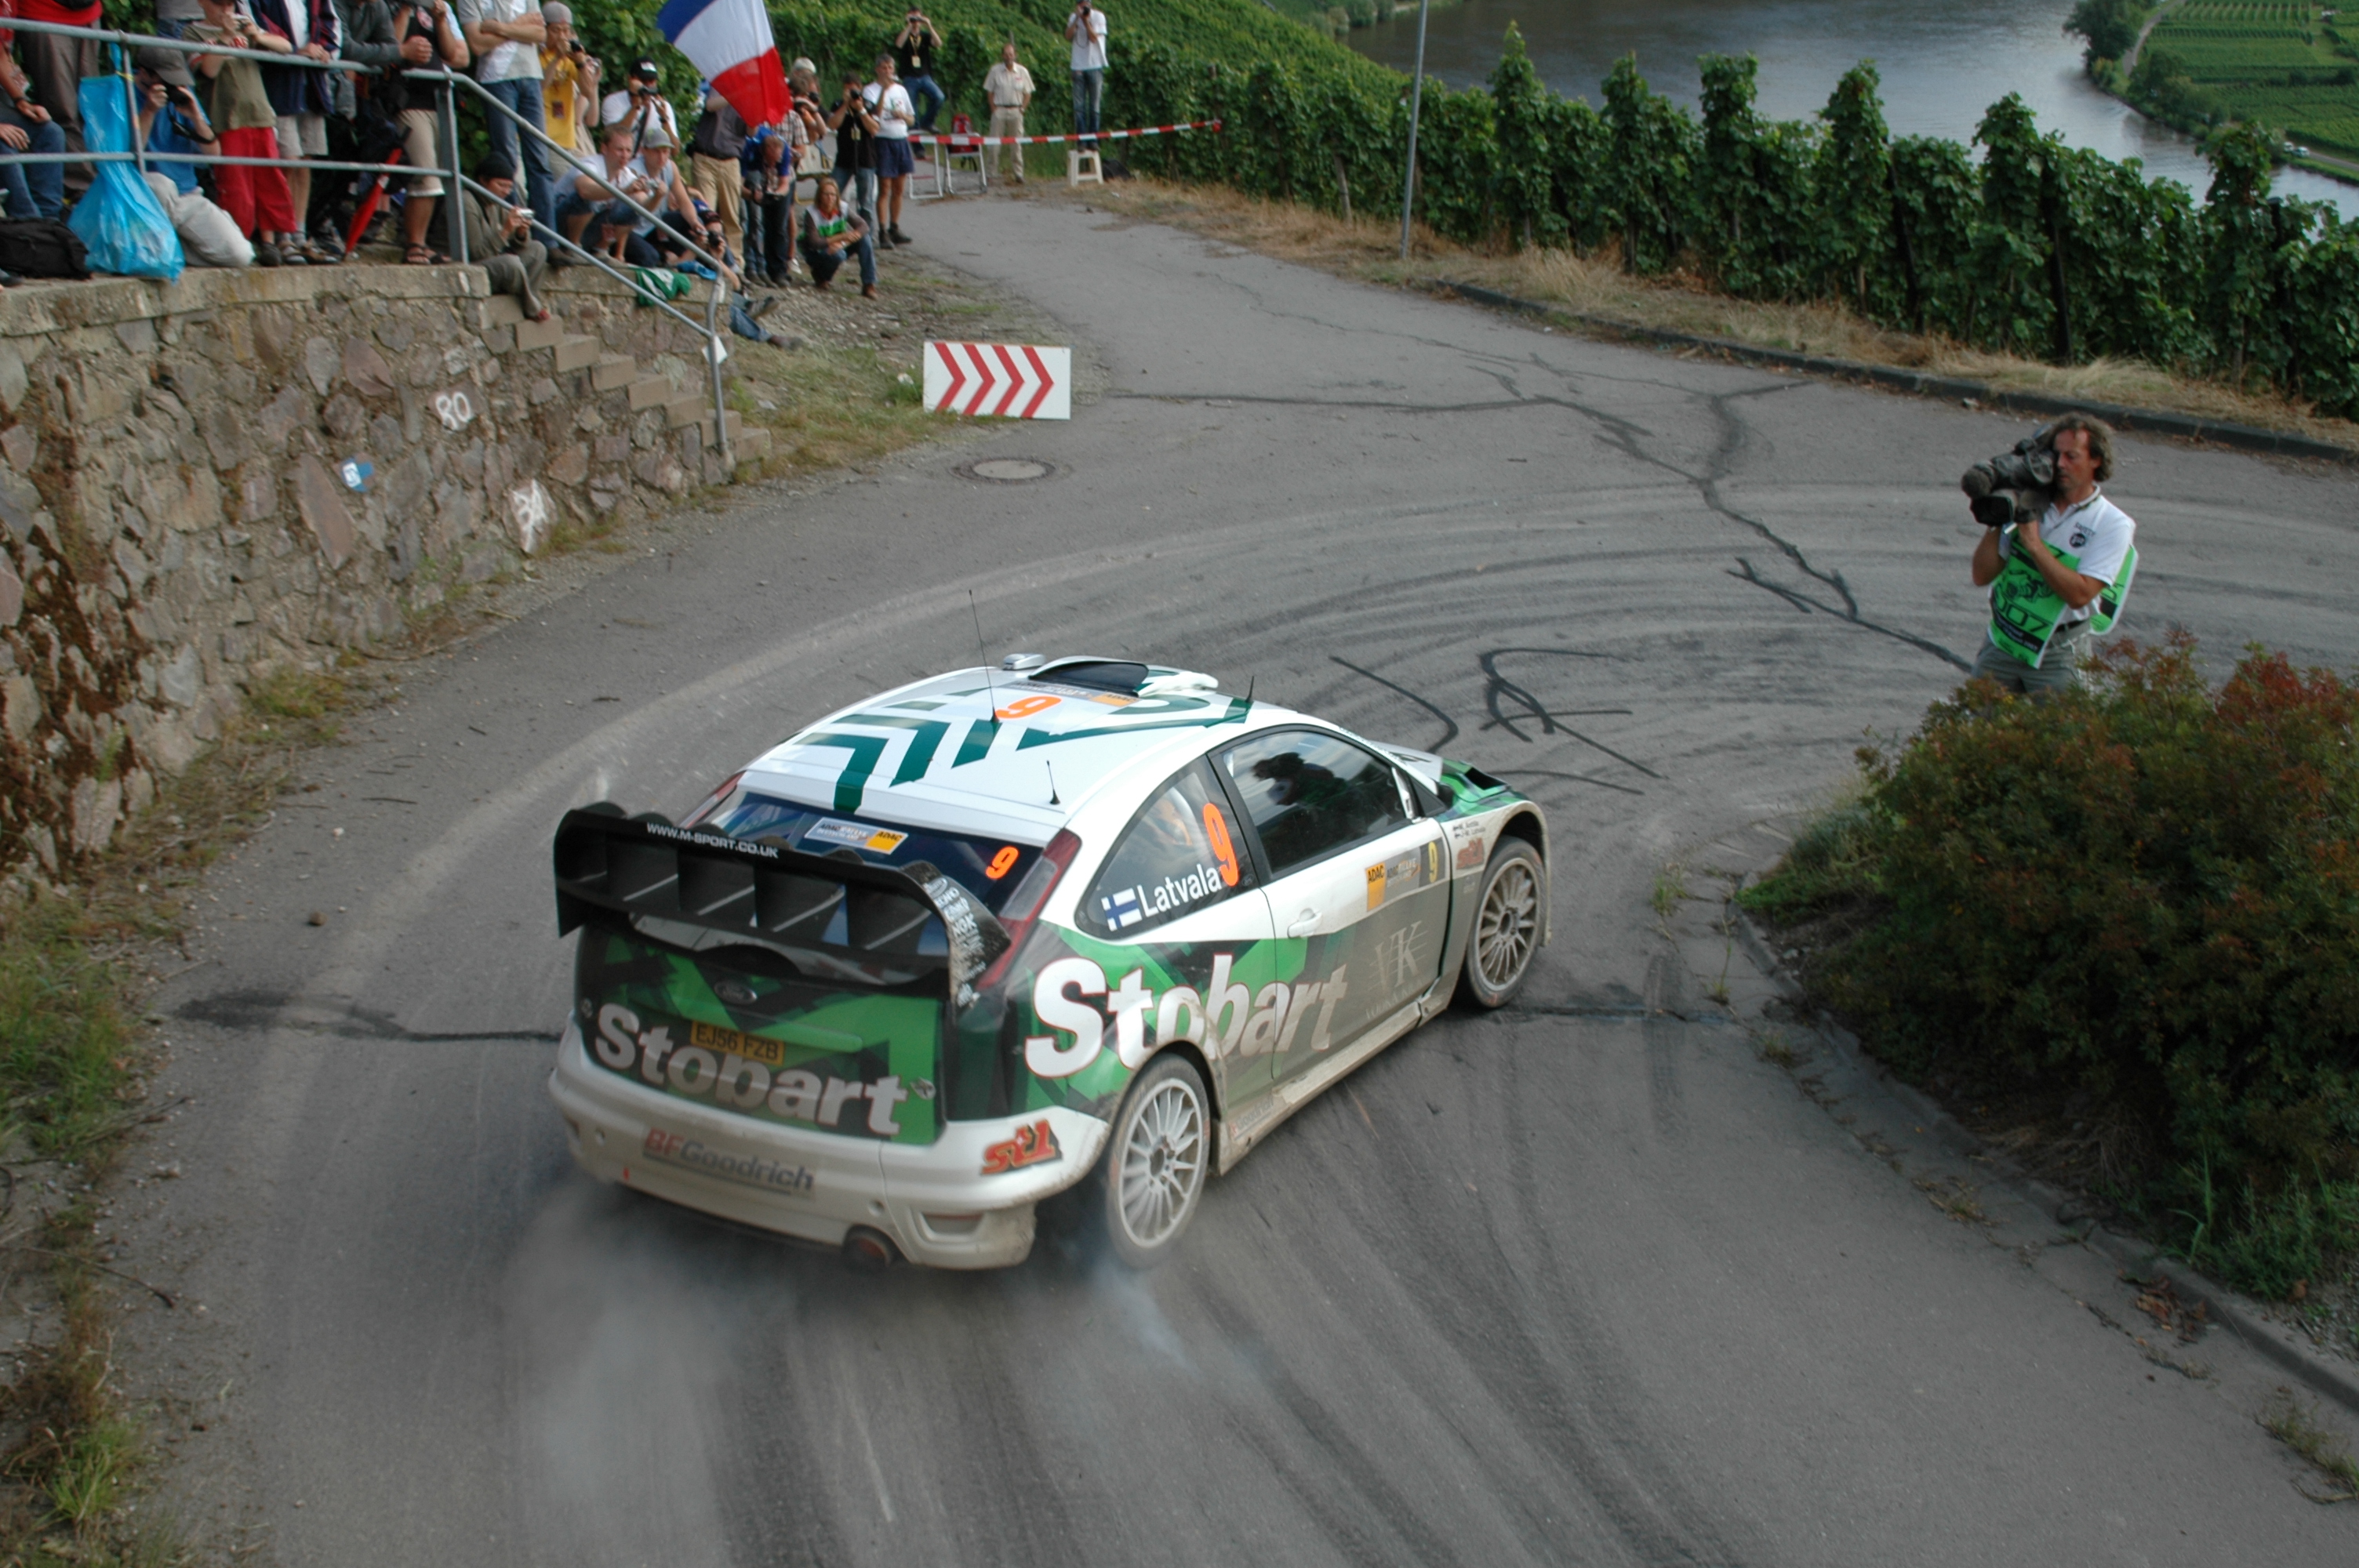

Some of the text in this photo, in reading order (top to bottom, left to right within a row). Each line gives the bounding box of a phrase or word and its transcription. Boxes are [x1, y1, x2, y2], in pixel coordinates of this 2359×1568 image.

[994, 695, 1063, 719] 9
[646, 822, 779, 858] WWW.M-SPORT.CO.UK
[986, 847, 1019, 880] 9
[1203, 803, 1239, 887] 9
[1429, 840, 1438, 884] 9
[1137, 864, 1223, 917] Latvala
[1368, 864, 1385, 884] ADAC
[1025, 953, 1347, 1077] Stobart
[594, 1004, 908, 1136] Stobart
[643, 1127, 814, 1190] BFGoodrich
